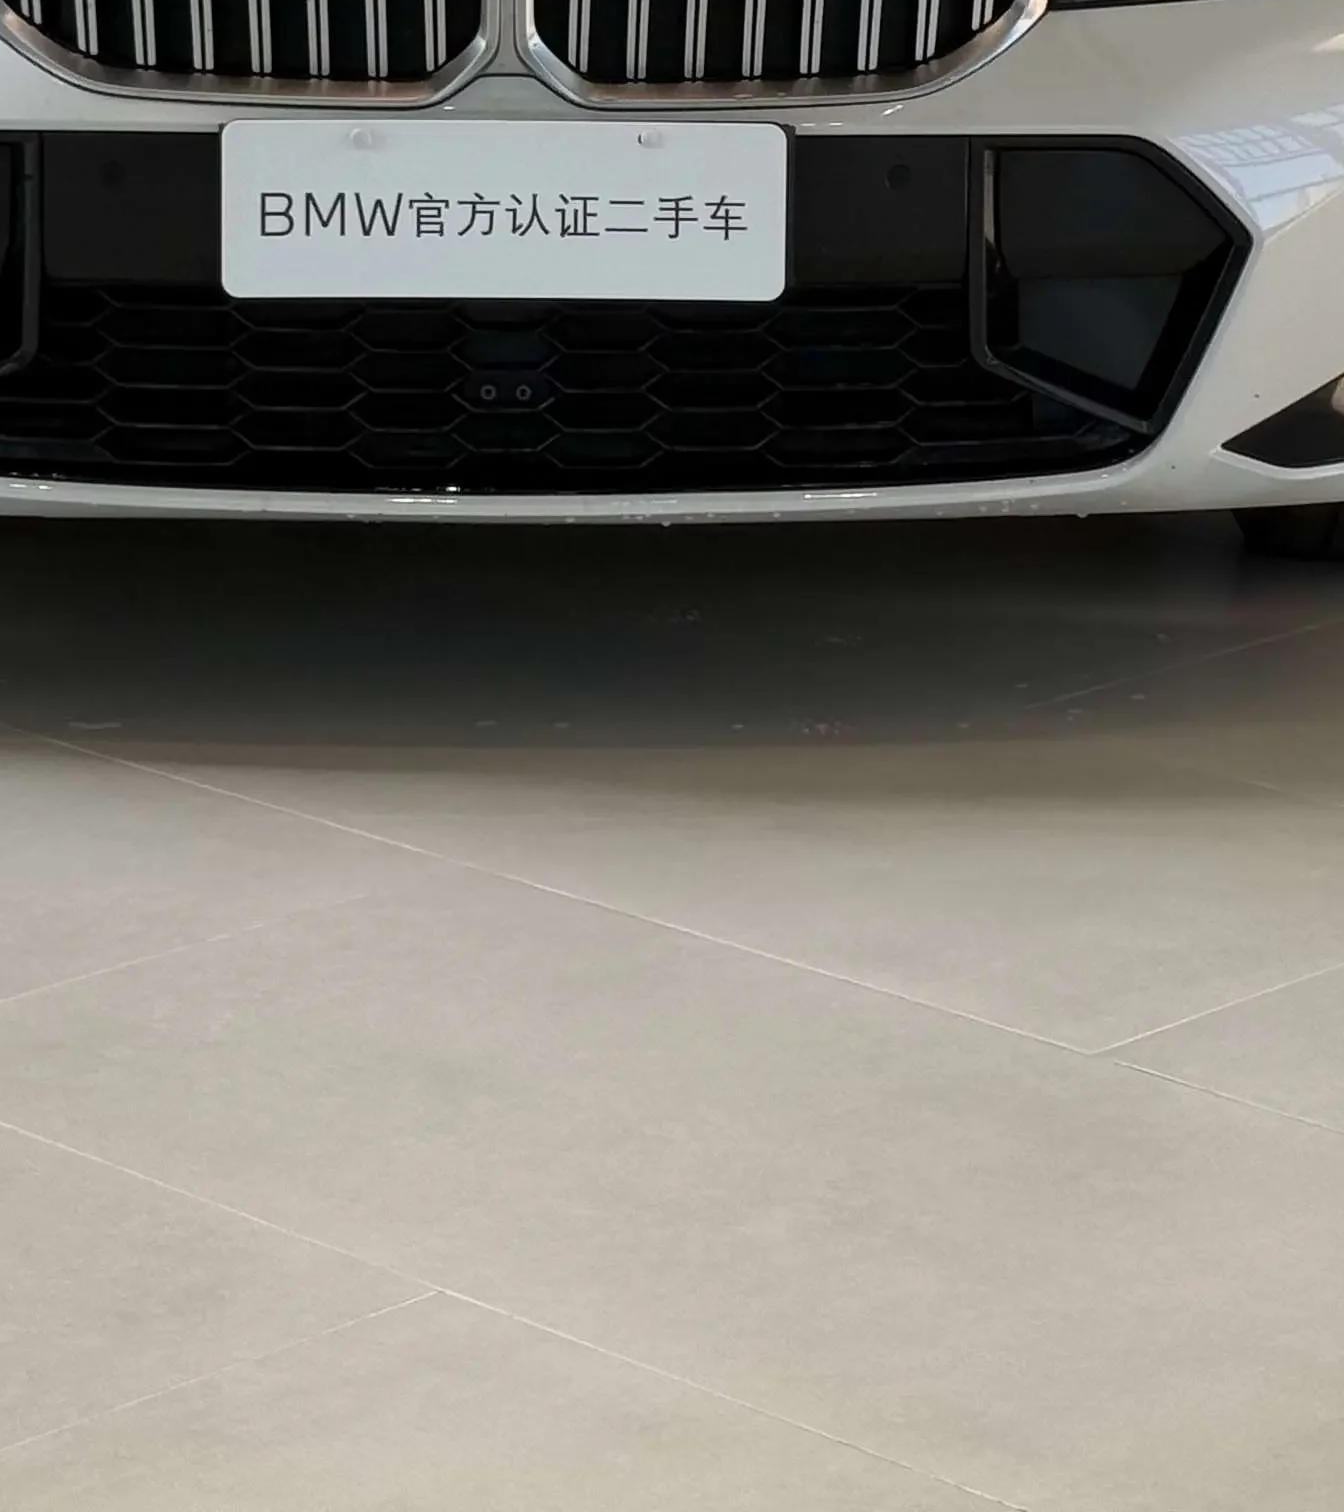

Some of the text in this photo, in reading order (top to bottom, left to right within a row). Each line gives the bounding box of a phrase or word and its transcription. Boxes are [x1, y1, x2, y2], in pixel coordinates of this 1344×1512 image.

[259, 191, 748, 241] BMW官方认证二手车
